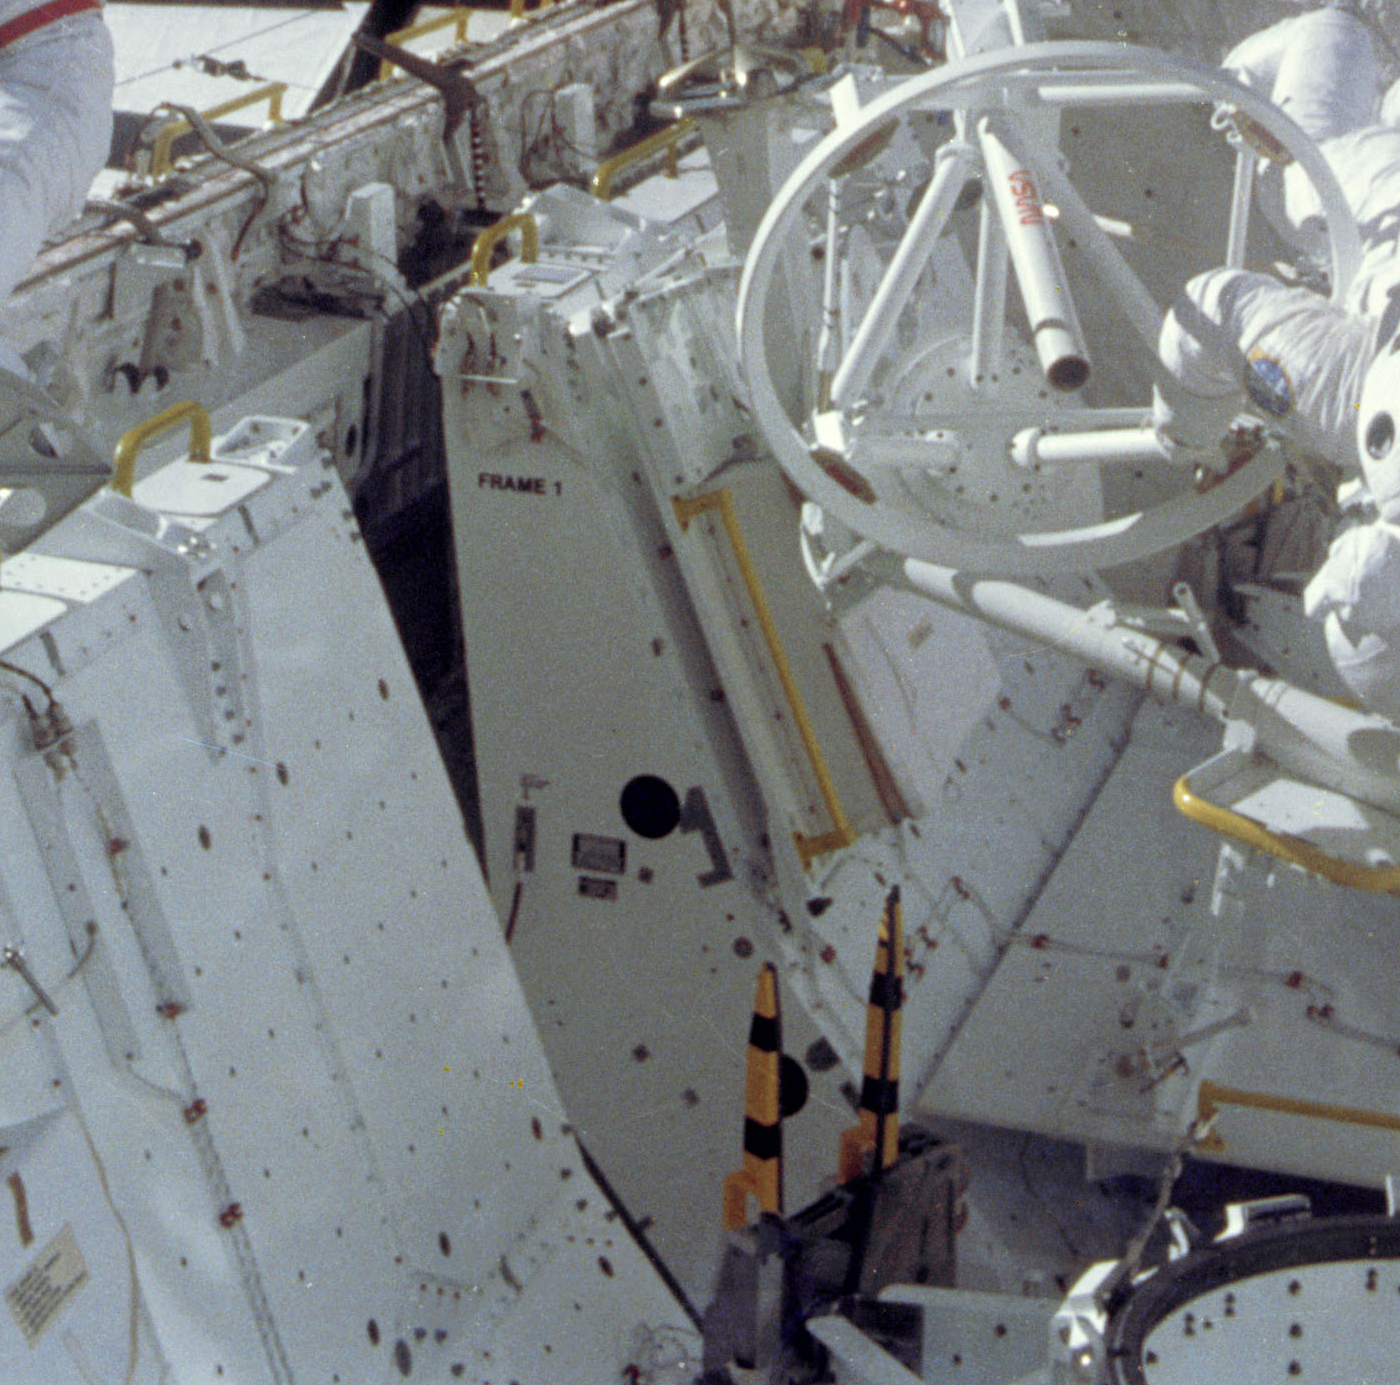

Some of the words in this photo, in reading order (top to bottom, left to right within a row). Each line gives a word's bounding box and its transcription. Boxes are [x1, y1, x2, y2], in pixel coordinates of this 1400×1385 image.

[1008, 170, 1045, 225] NASA
[478, 472, 546, 496] FRAME
[554, 480, 563, 497] 1
